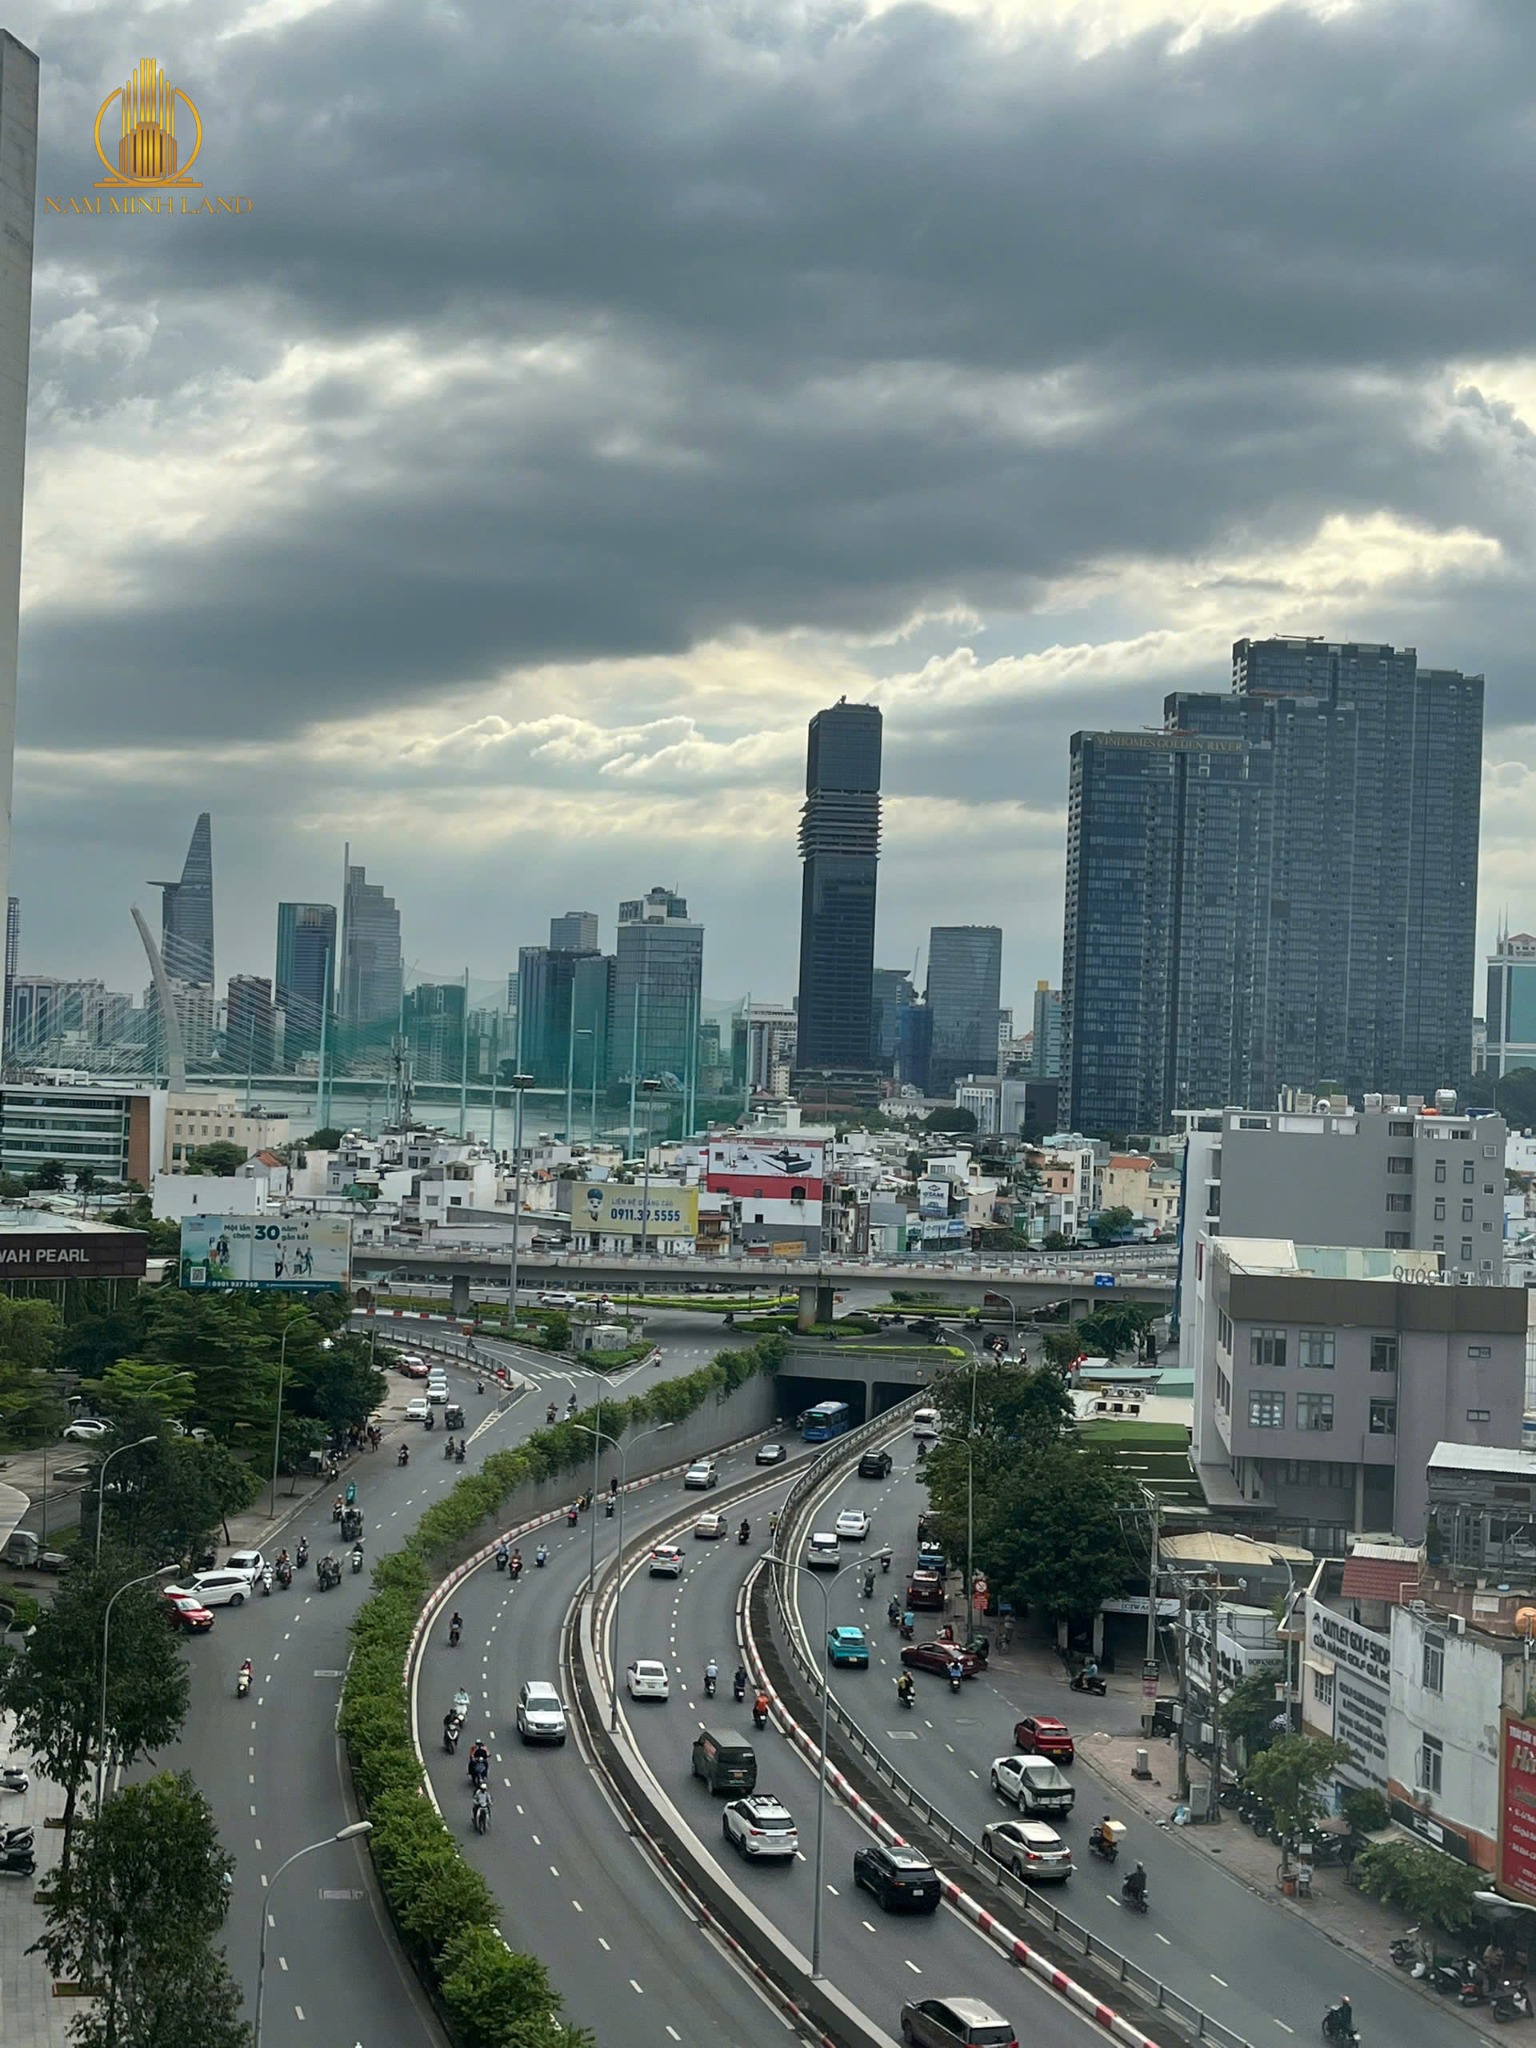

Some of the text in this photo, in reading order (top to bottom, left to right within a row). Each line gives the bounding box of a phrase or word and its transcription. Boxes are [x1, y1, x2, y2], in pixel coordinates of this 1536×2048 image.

[1096, 736, 1243, 751] VINHOMES GOLDEN RIVER
[254, 1224, 280, 1240] 30
[36, 1248, 90, 1263] PEARL
[1322, 1617, 1349, 1647] OUTLET
[1349, 1631, 1370, 1656] GOLF
